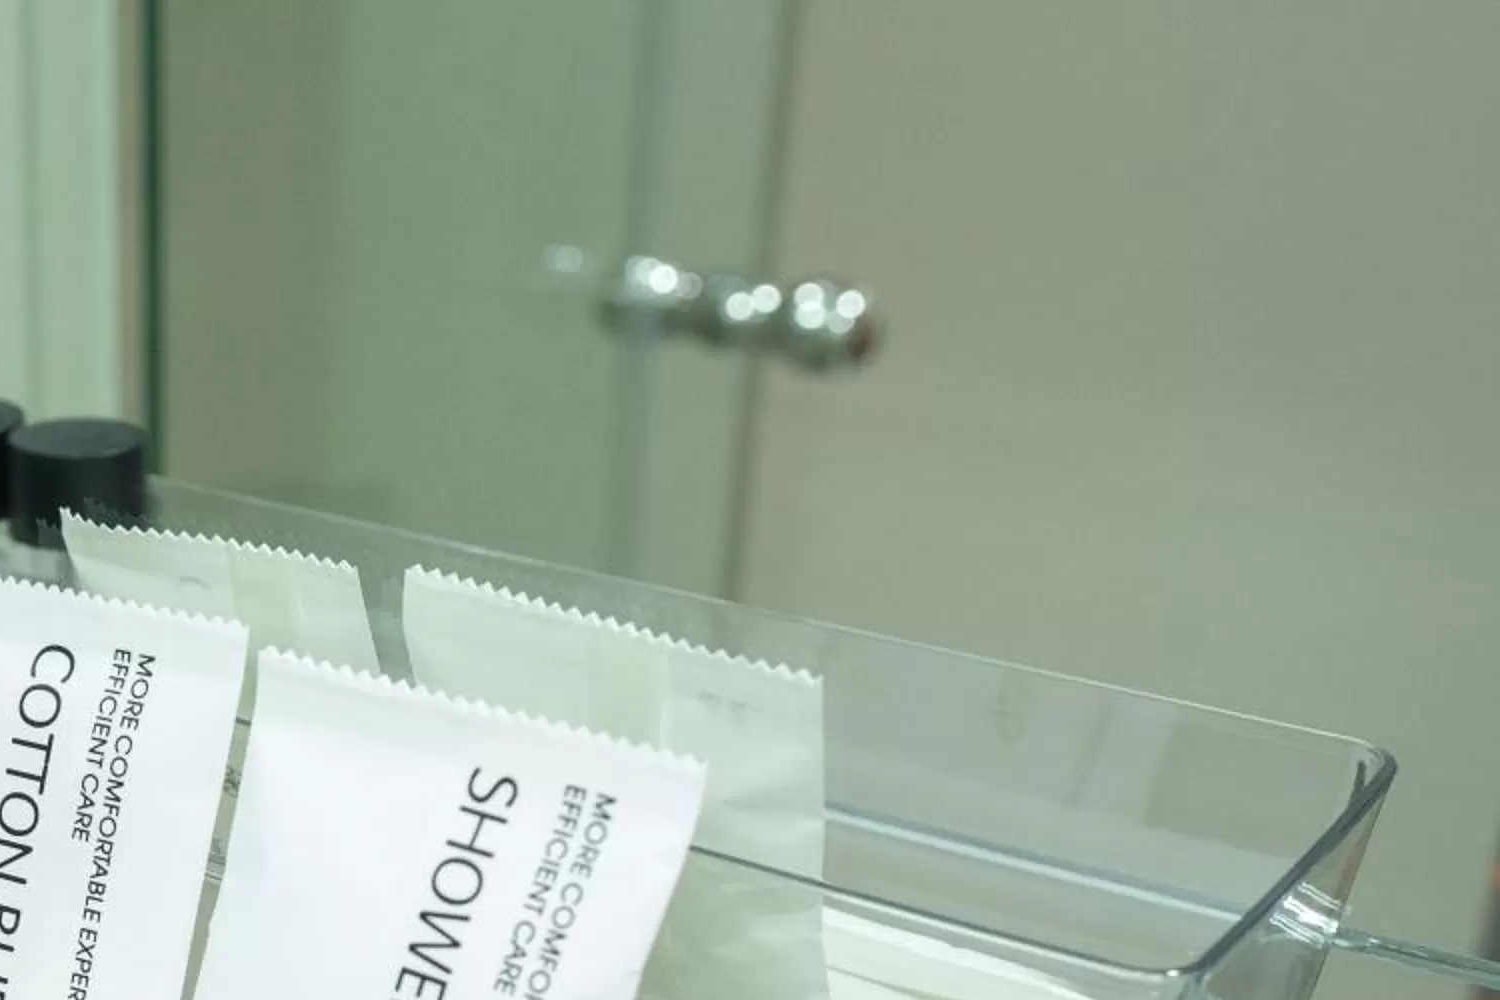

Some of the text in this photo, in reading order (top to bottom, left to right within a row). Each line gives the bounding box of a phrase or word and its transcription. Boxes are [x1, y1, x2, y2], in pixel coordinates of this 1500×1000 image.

[71, 648, 131, 843] EFFICIENT CARE
[119, 652, 156, 731] MORE
[81, 734, 133, 923] COMFORTABLE
[493, 783, 588, 997] EFFICIENT CARE
[568, 791, 618, 879] MORE
